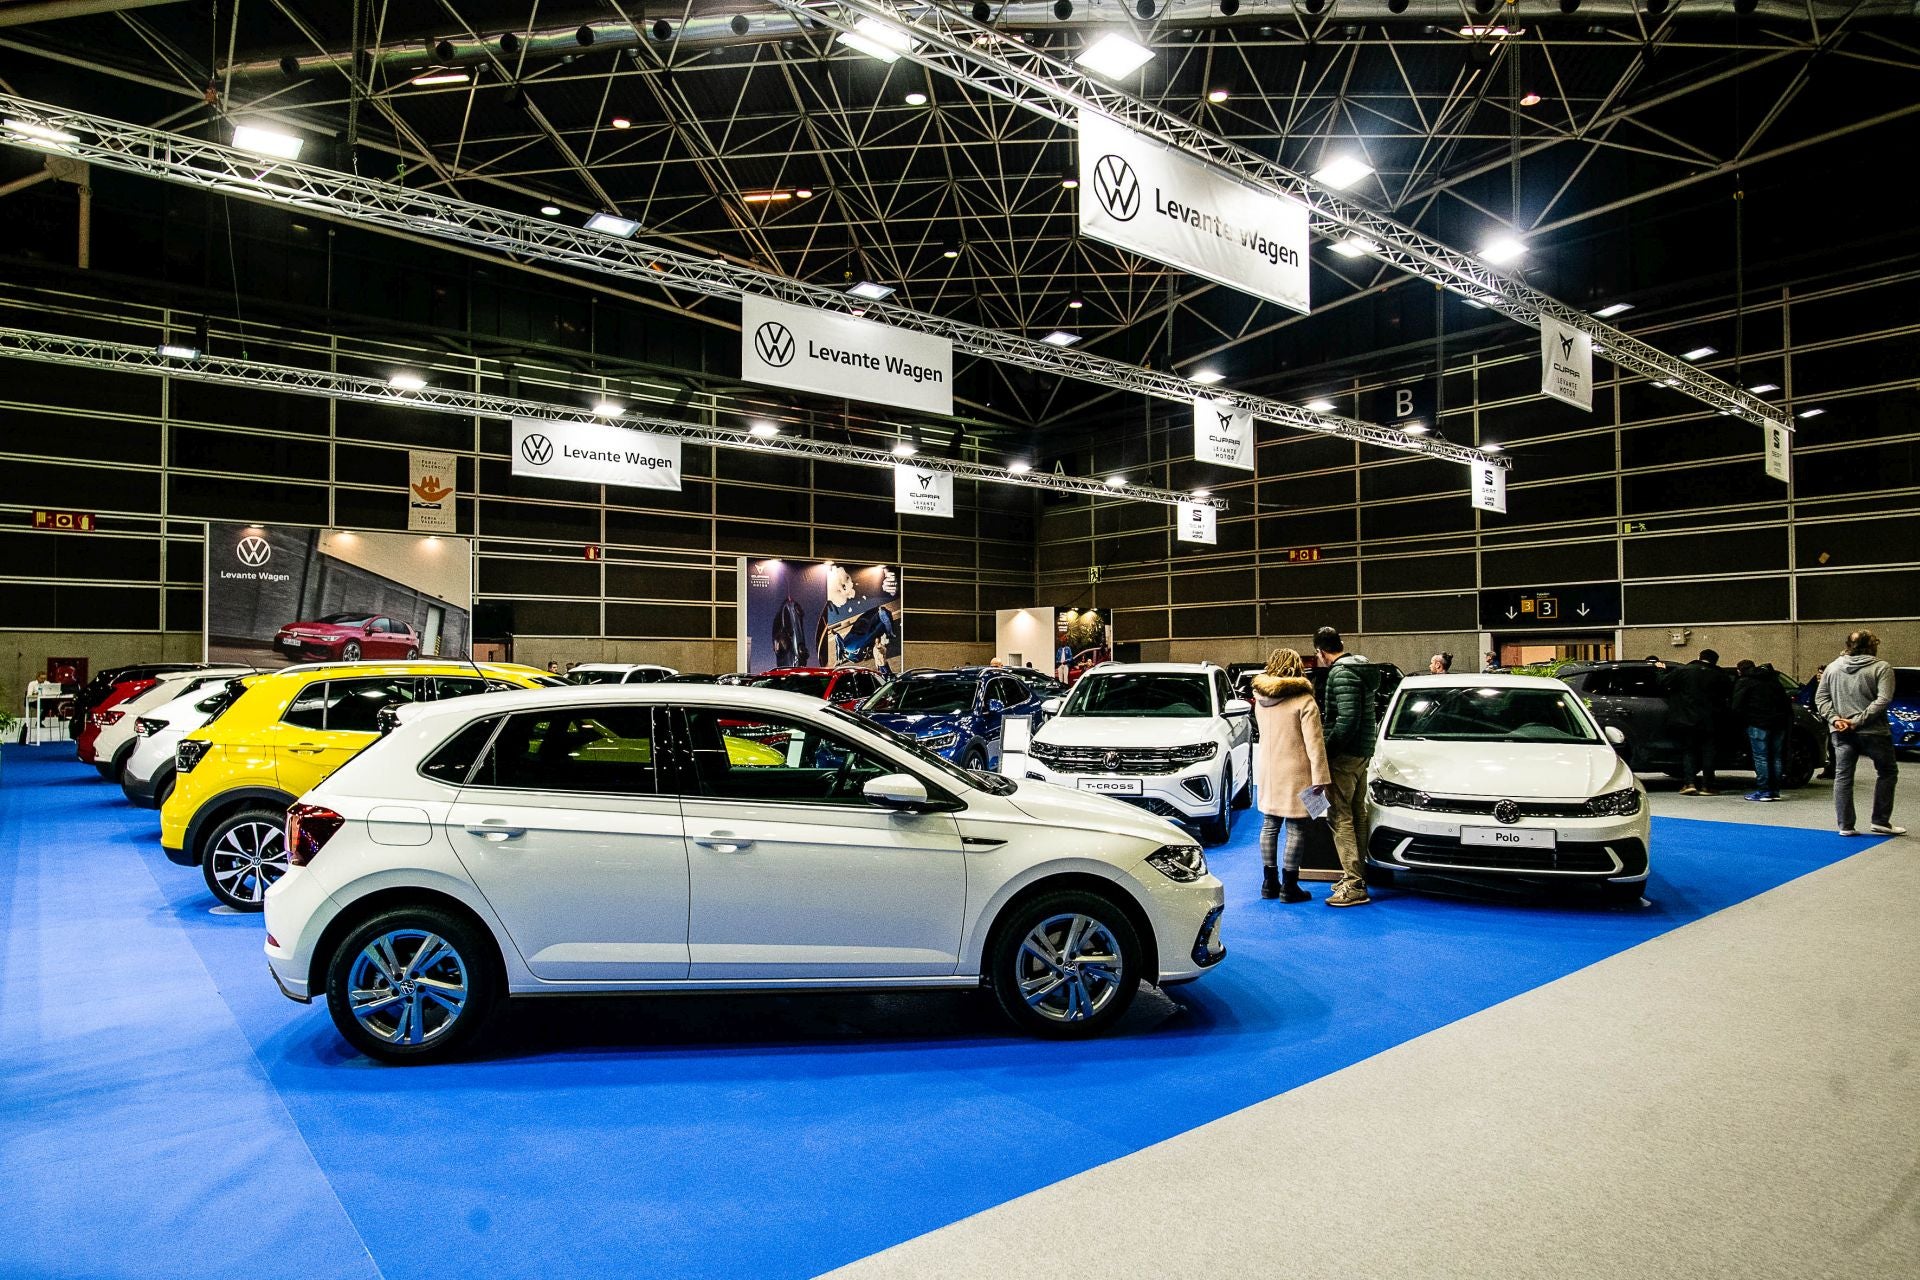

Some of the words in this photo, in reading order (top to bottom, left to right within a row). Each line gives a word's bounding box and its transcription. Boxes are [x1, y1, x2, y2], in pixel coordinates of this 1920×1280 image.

[1155, 188, 1233, 241] Levante
[1239, 226, 1299, 268] Wagen
[809, 340, 880, 370] Levante
[885, 355, 943, 383] Wagen
[1396, 389, 1414, 417] B
[564, 445, 621, 463] Levante
[625, 452, 672, 470] Wagen
[220, 570, 257, 579] Levante
[258, 572, 290, 582] Wagen
[1524, 601, 1531, 611] 3
[1542, 602, 1552, 615] 3
[1495, 833, 1520, 842] Polo
